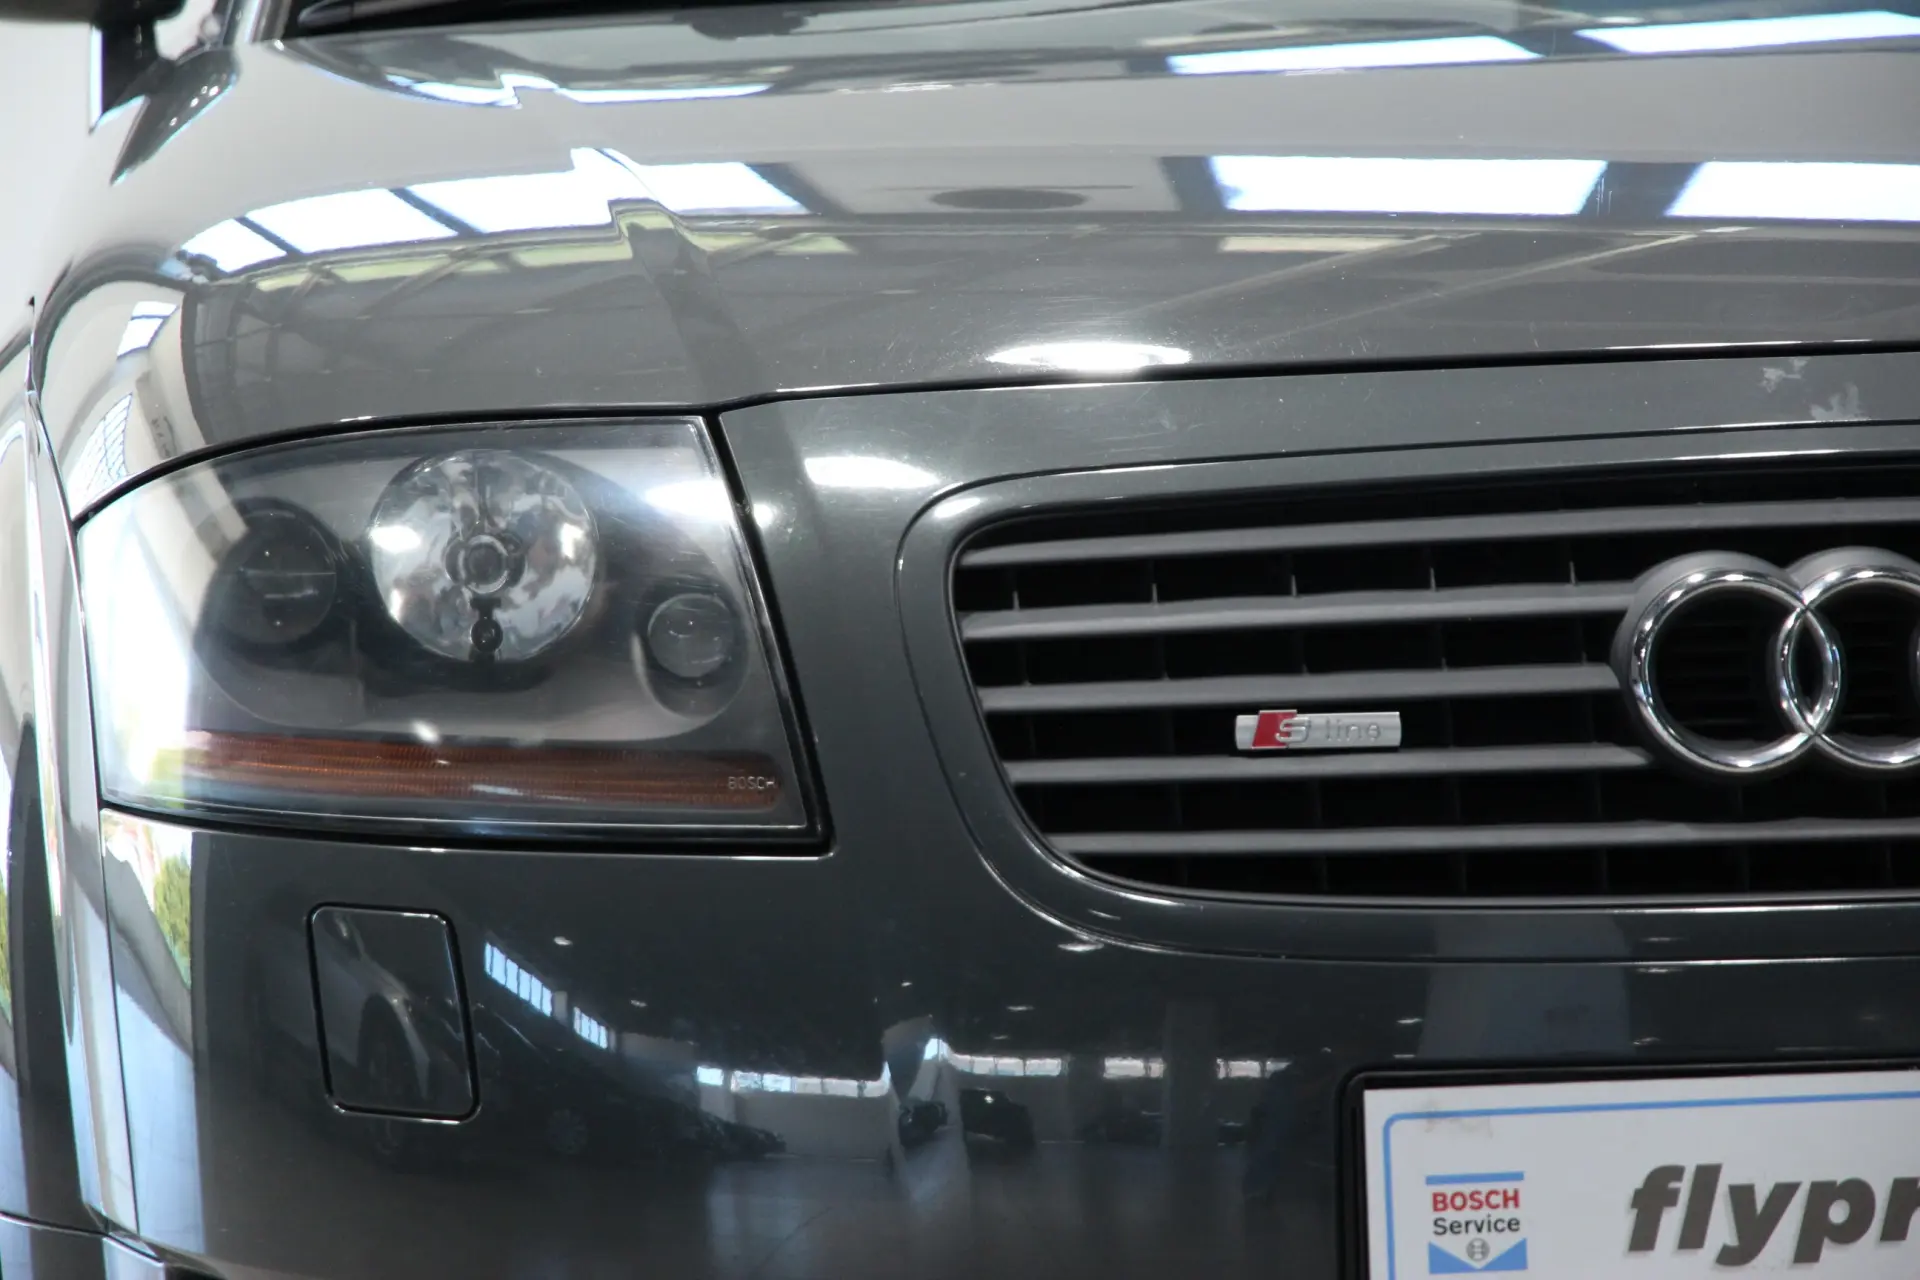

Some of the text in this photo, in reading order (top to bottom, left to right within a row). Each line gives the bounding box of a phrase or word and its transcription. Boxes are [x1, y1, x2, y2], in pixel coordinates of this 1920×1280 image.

[1275, 717, 1381, 744] S line
[728, 776, 776, 790] BOSCH
[1432, 1188, 1520, 1212] BOSCH
[1433, 1213, 1520, 1236] Service
